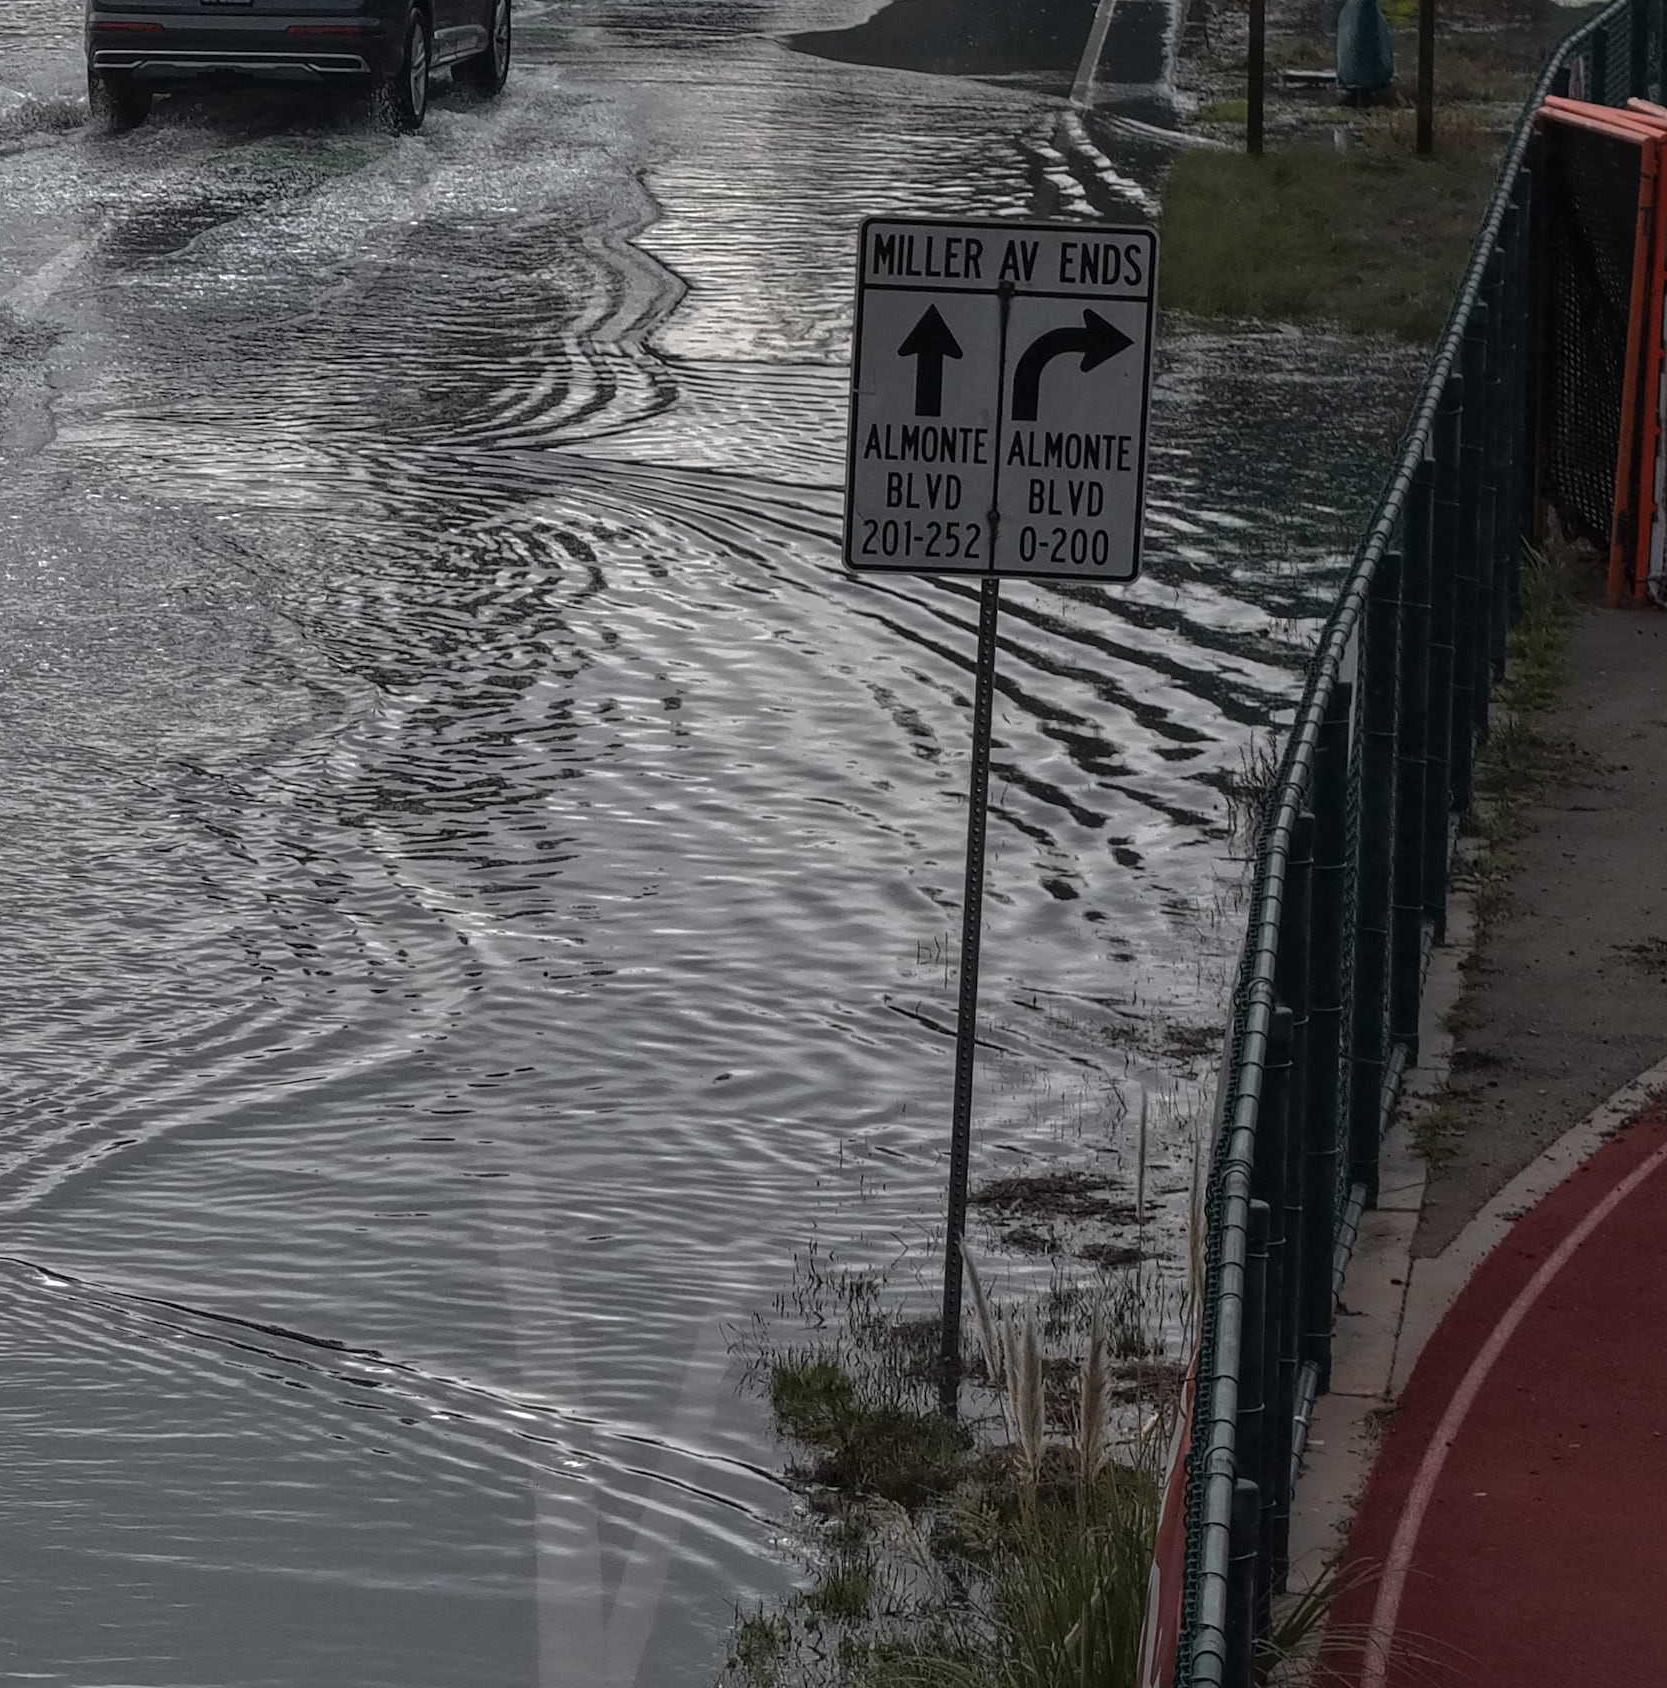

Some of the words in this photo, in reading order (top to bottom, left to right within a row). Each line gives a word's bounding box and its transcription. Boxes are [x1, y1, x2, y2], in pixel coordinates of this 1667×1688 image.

[872, 233, 983, 280] MILLER
[999, 238, 1039, 281] AV
[1059, 242, 1142, 286] ENDS
[863, 424, 988, 465] ALMONTE
[1006, 431, 1132, 472] ALMONTE
[886, 472, 962, 511] BLVD
[1028, 478, 1105, 518] BLVD
[861, 518, 981, 560] 201-252
[1019, 525, 1110, 565] 0-200
